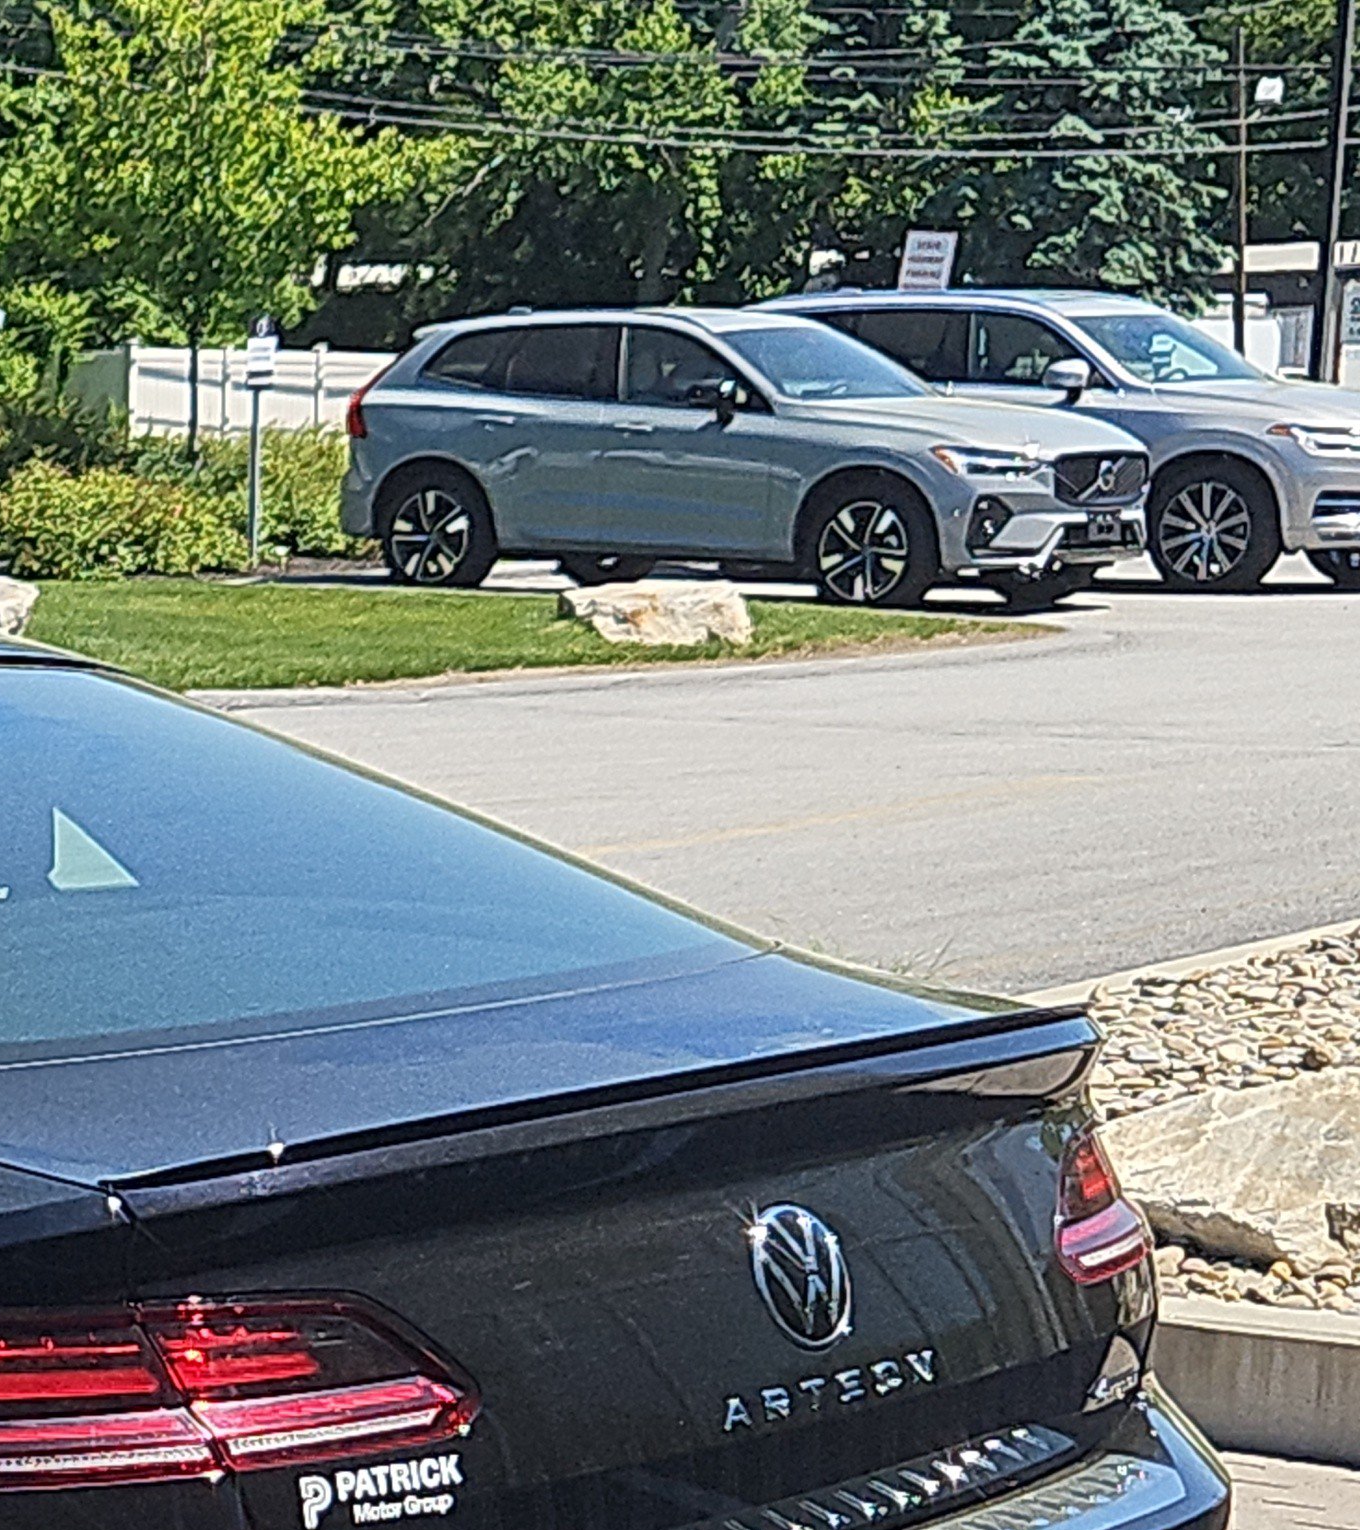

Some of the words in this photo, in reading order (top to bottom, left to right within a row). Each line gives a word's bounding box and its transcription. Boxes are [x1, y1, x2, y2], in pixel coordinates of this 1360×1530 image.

[335, 1454, 463, 1501] PATRICK
[353, 1502, 402, 1524] Motor
[403, 1493, 454, 1515] Group
